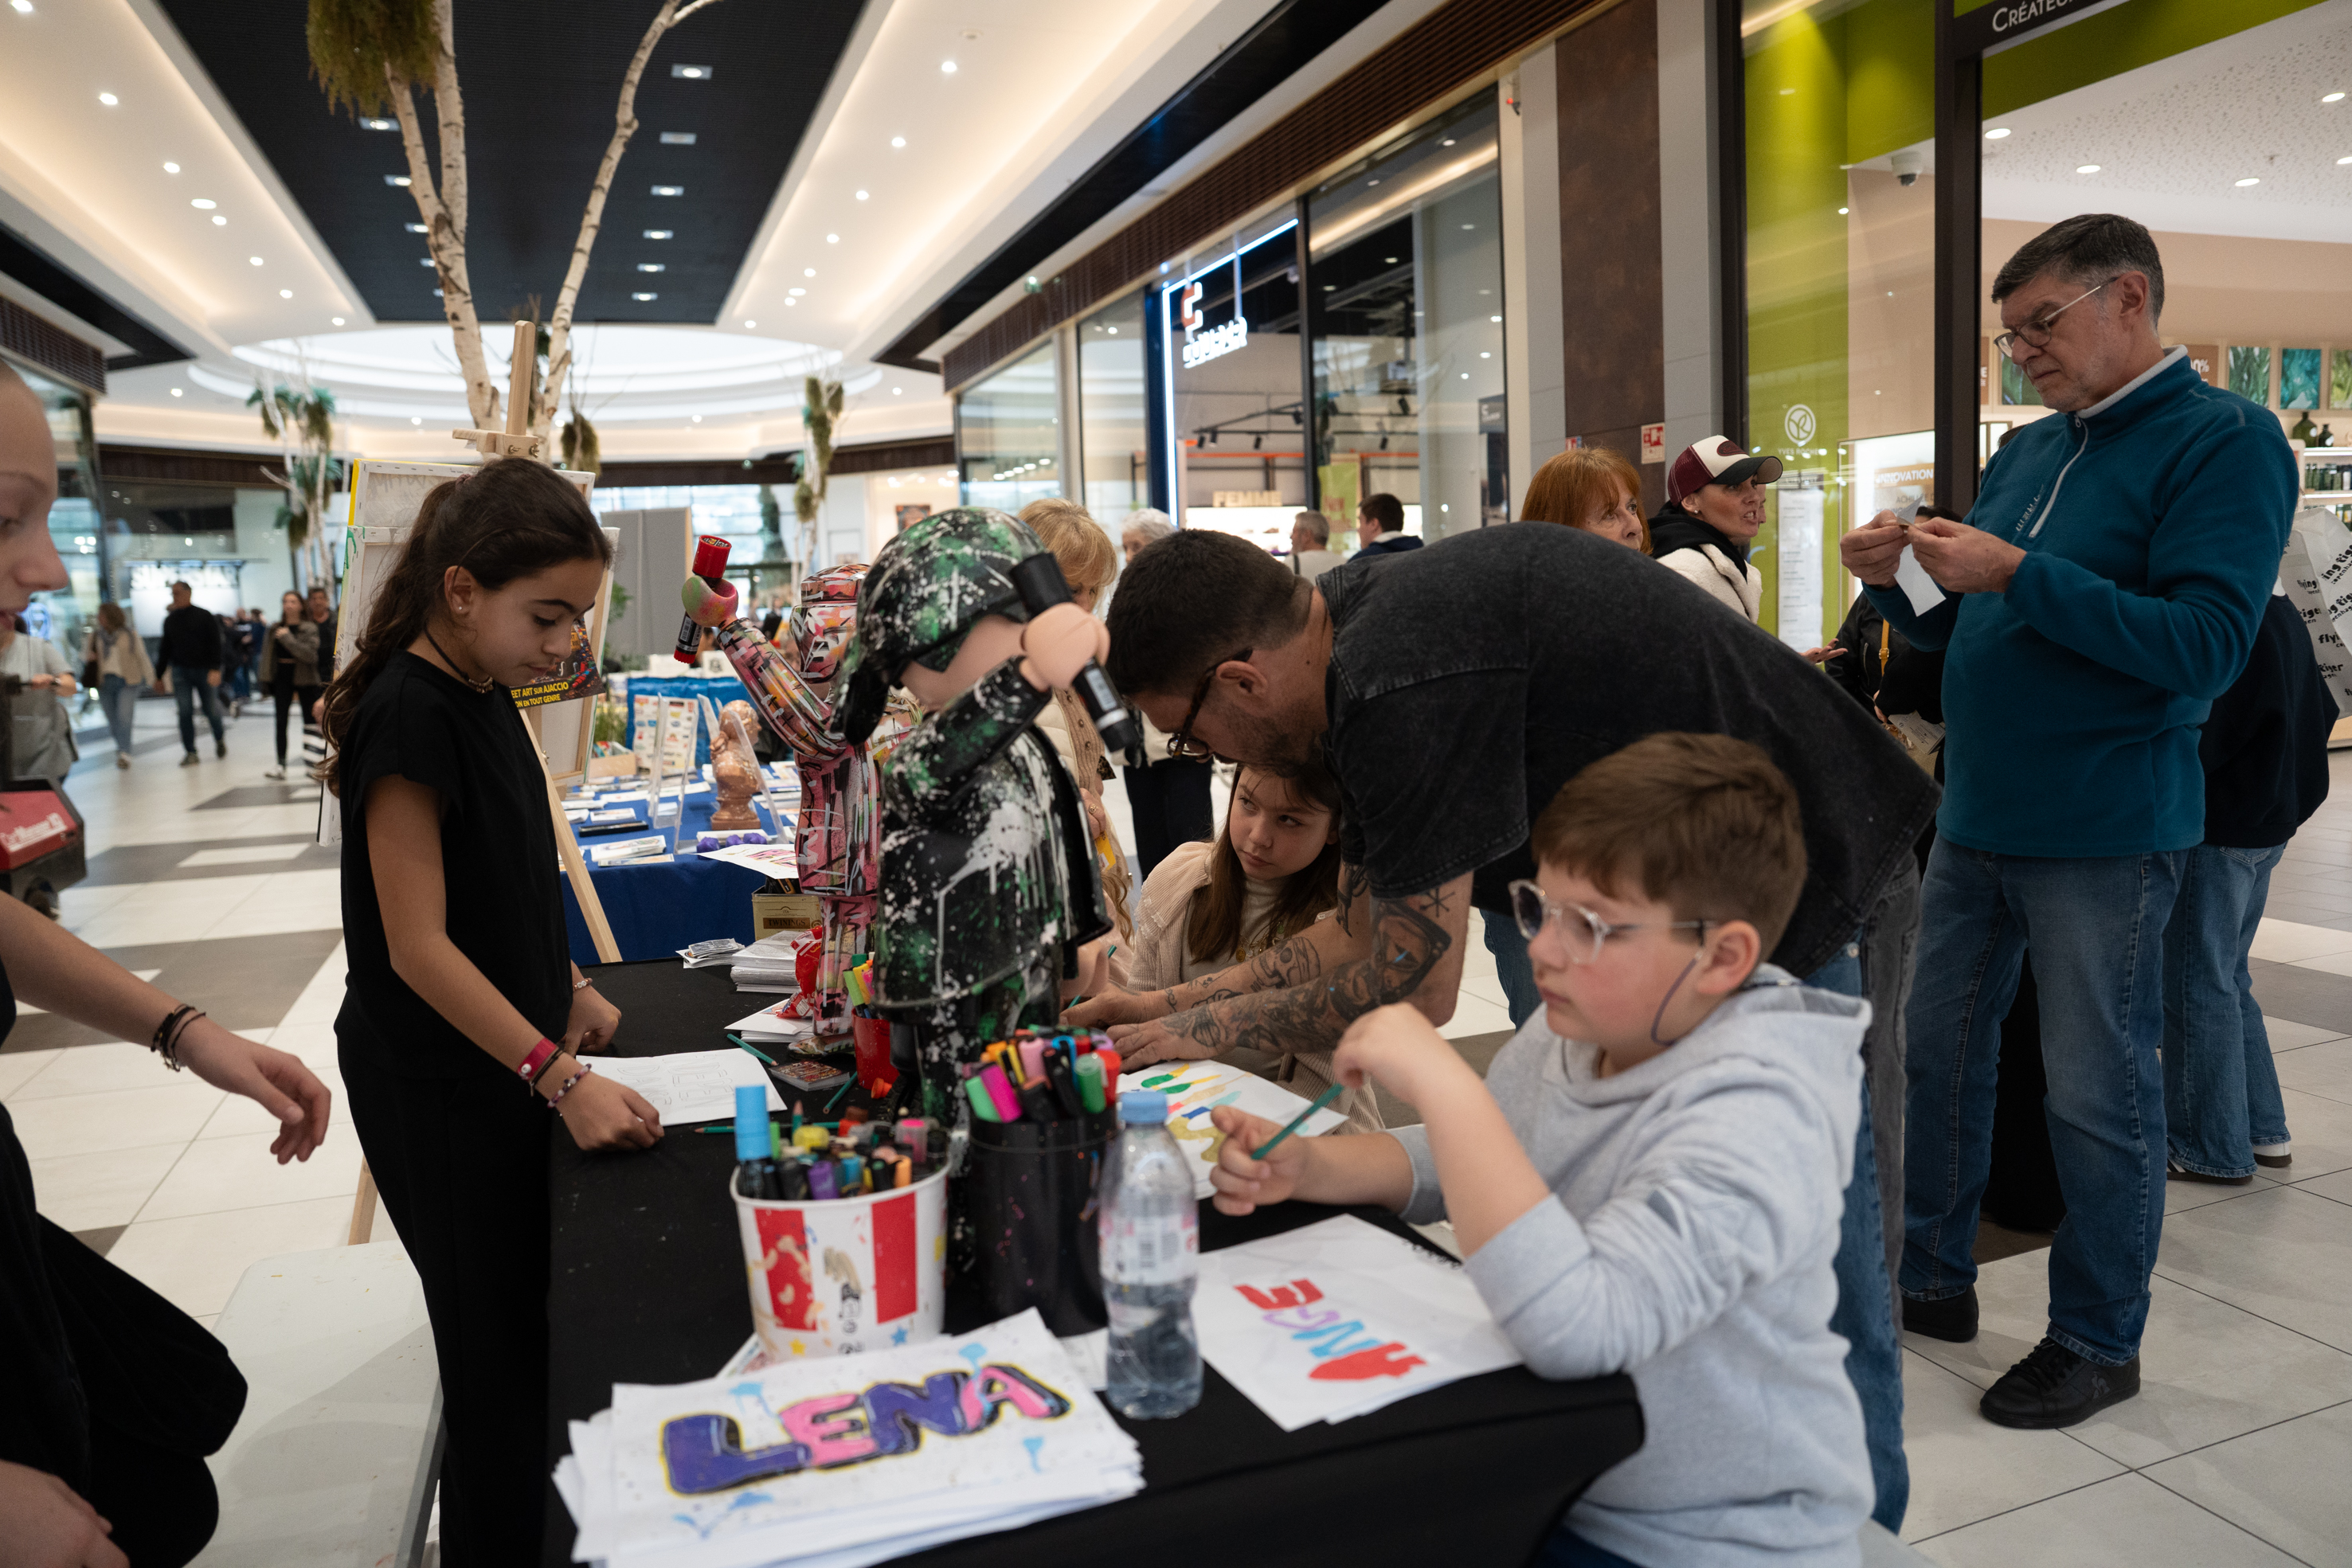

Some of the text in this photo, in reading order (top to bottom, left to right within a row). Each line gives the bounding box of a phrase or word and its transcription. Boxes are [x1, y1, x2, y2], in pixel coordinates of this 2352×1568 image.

[1992, 0, 2072, 31] CRÉATE
[1877, 468, 1934, 483] INNOVATION
[1212, 491, 1283, 507] FEMME
[2319, 632, 2340, 643] flyi
[522, 686, 533, 697] ART
[533, 686, 543, 695] SUR
[543, 681, 569, 694] AJACCIO
[529, 696, 543, 706] TOUT
[543, 694, 561, 703] GENRE
[769, 918, 806, 927] TWININGS
[660, 1362, 1073, 1496] LENA
